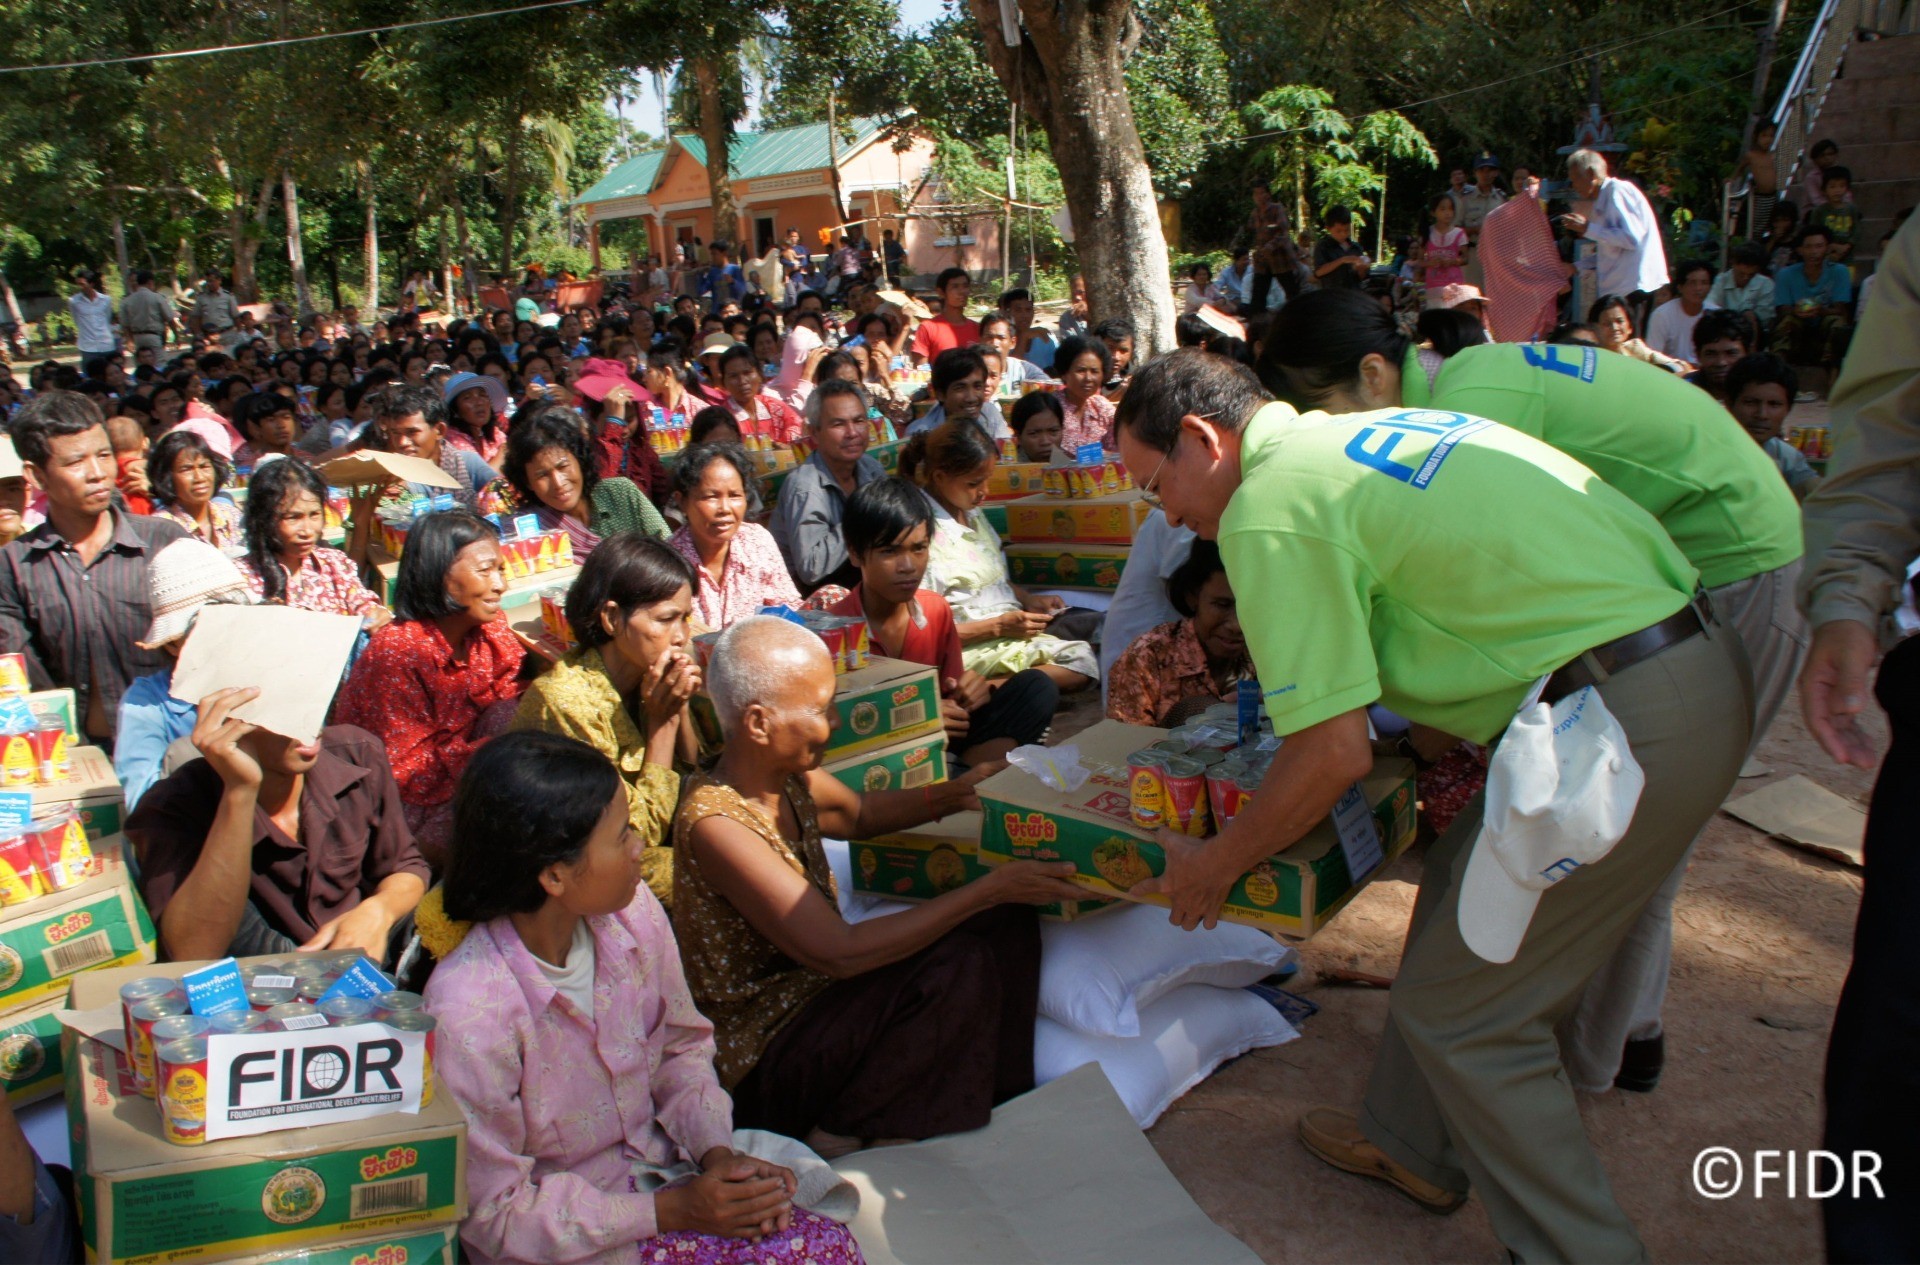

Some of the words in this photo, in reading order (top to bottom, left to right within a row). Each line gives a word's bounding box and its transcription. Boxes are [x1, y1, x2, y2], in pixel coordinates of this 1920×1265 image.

[1414, 442, 1451, 485] FOUNDATION
[228, 1038, 404, 1107] FIDR
[229, 1105, 272, 1120] FOUNDATION
[272, 1103, 285, 1115] FOR
[286, 1099, 334, 1113] INTERNATIONAL
